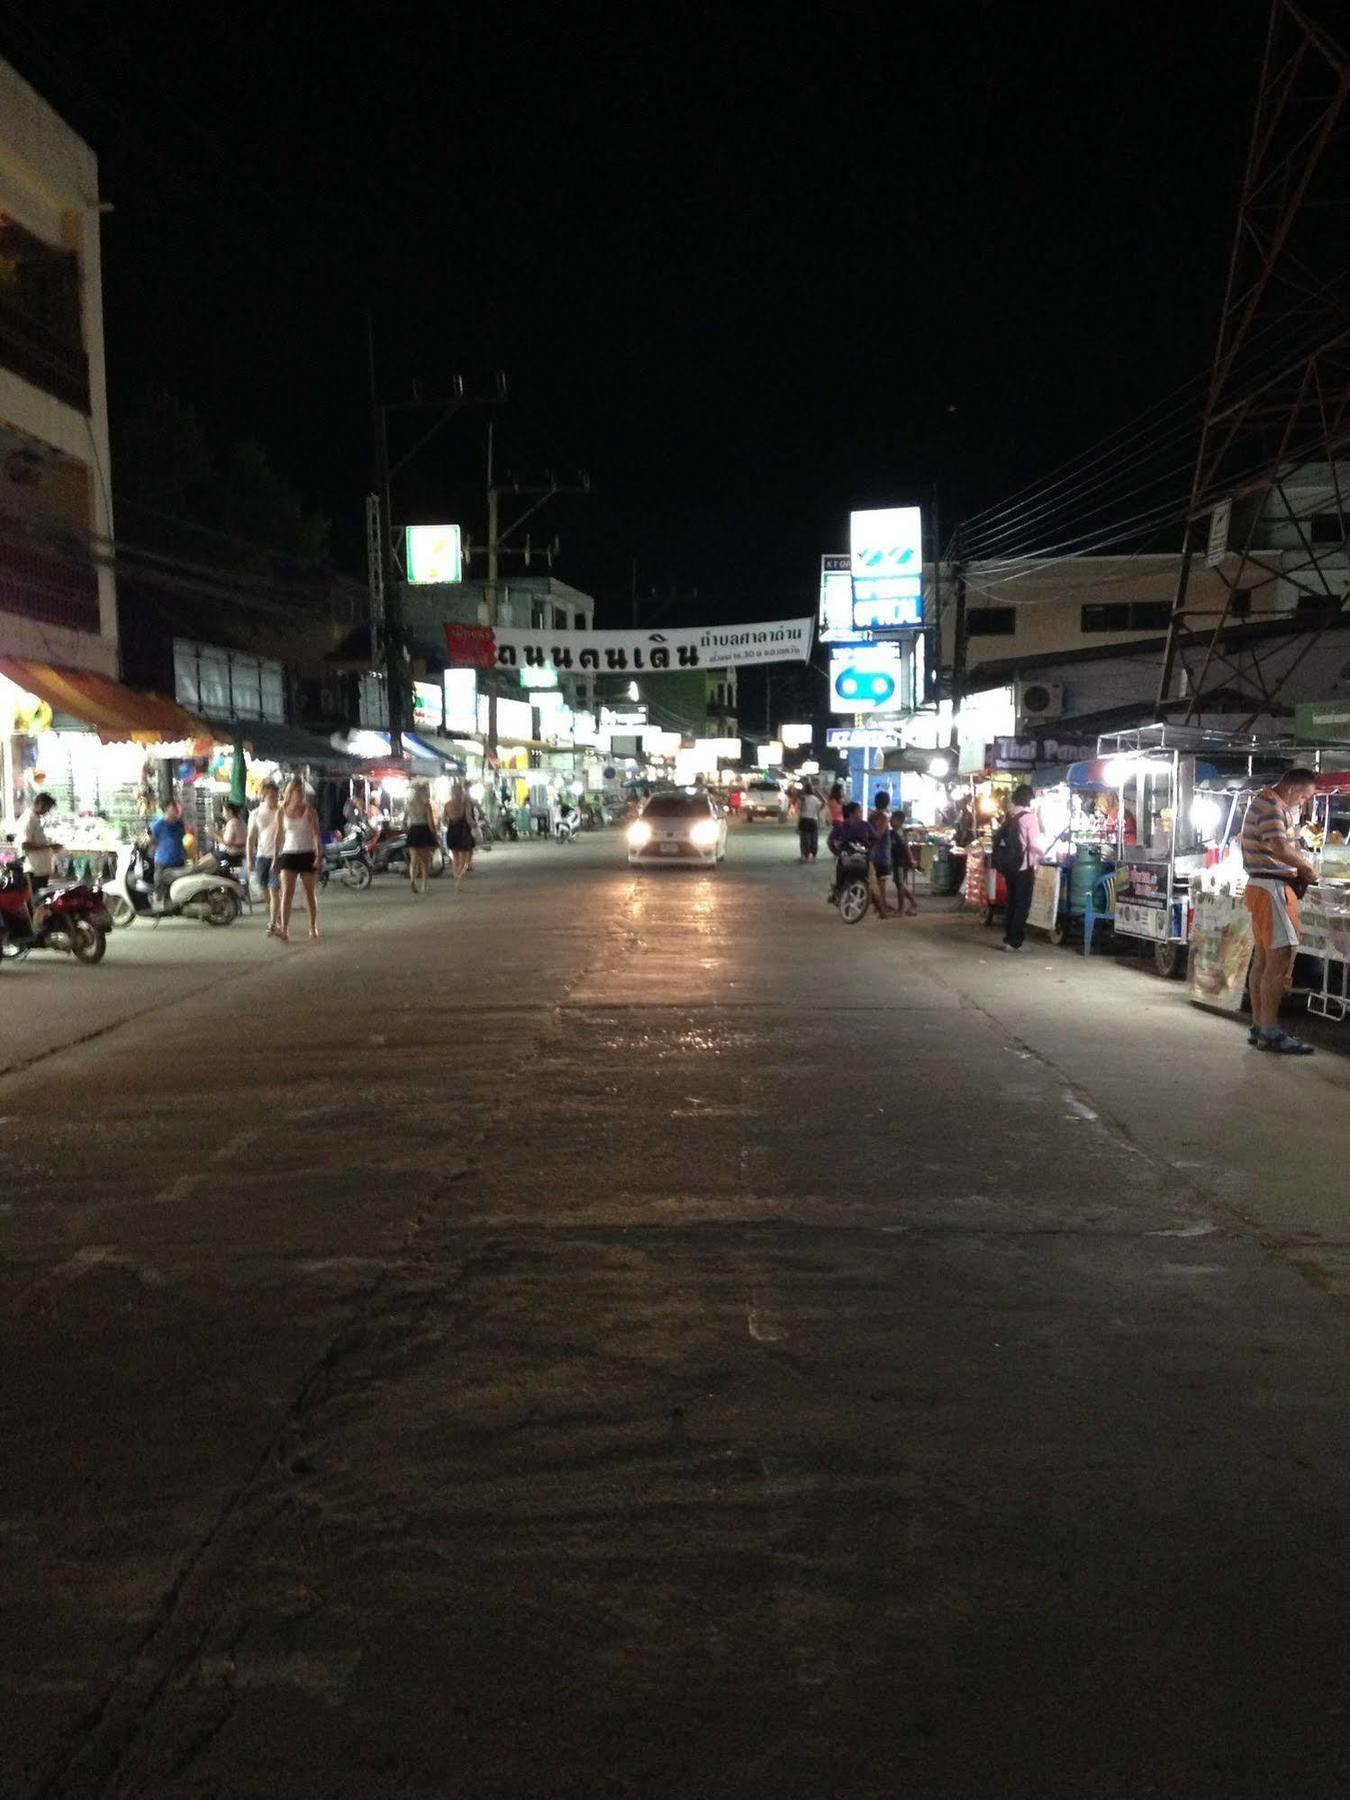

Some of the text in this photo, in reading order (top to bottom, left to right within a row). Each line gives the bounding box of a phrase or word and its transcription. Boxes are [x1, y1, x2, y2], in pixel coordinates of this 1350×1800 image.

[700, 625, 802, 647] ตำบลศาลาด่าน
[497, 633, 699, 669] ถนนคนเดิน
[997, 738, 1037, 760] Thai
